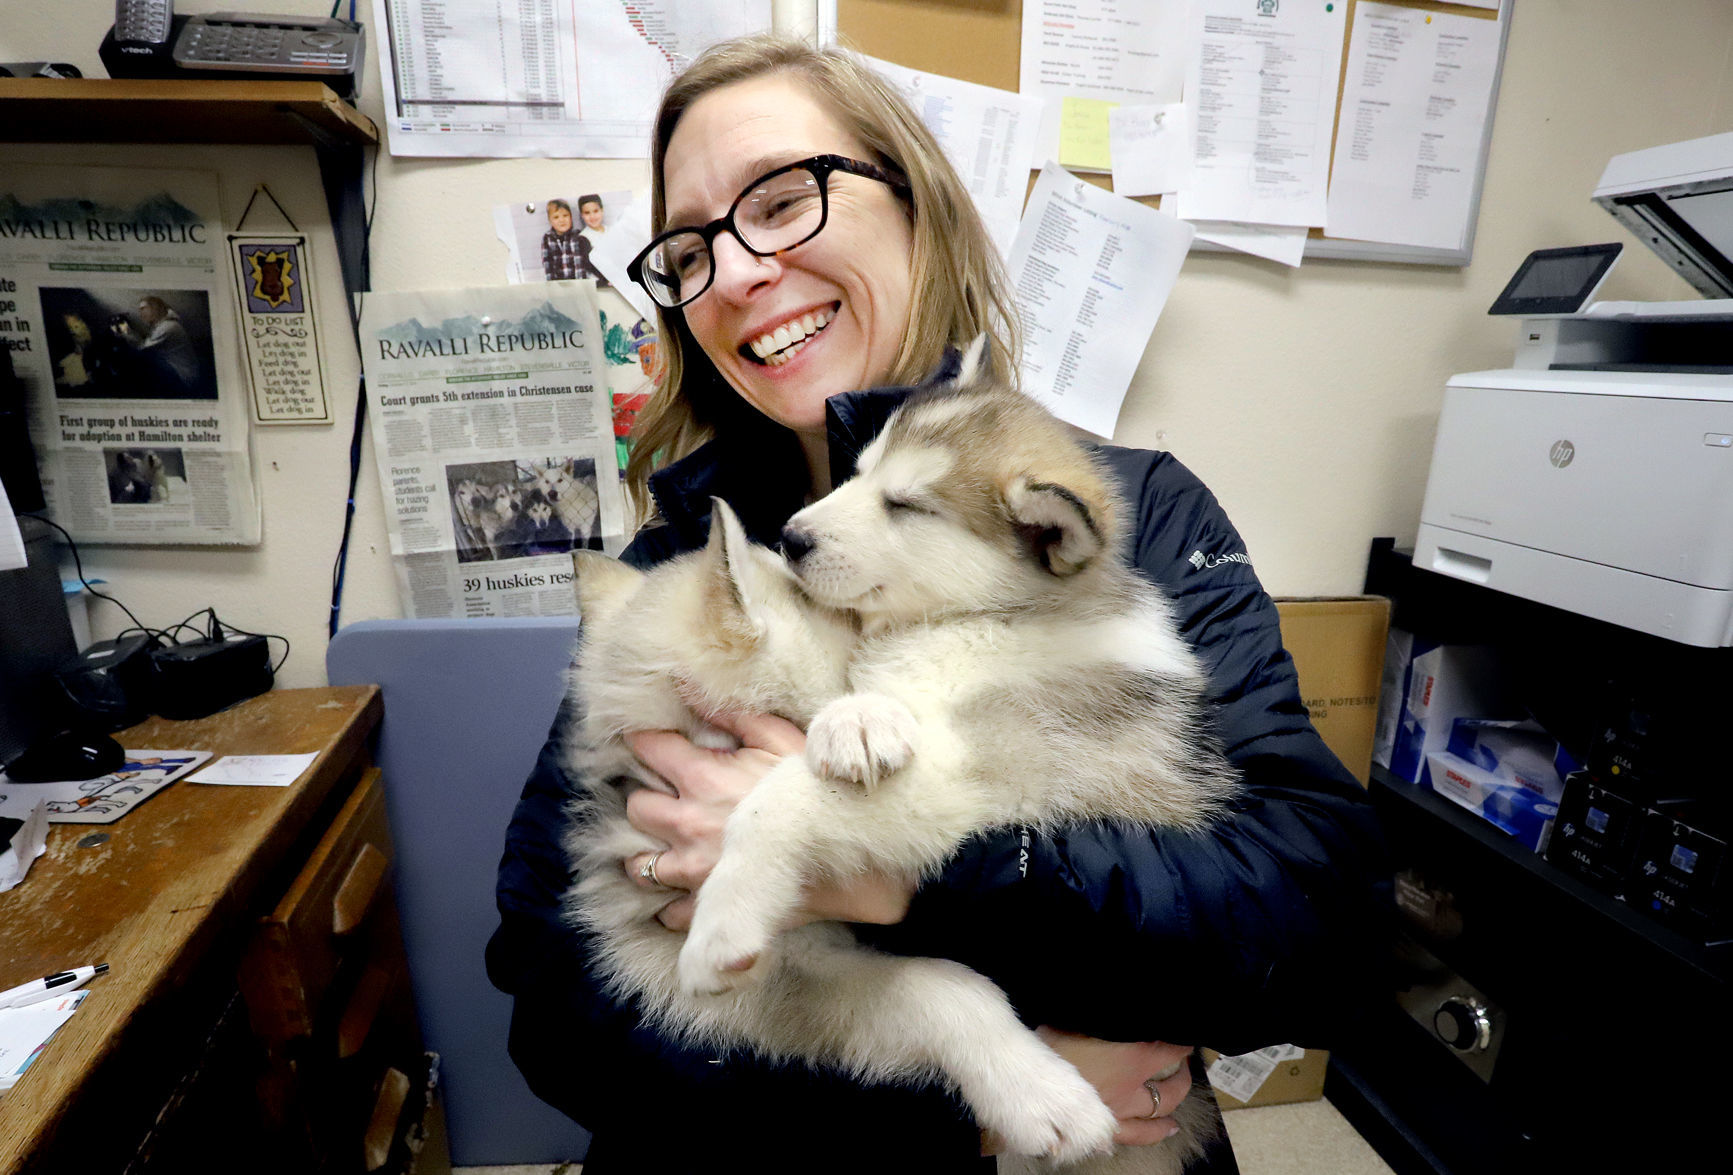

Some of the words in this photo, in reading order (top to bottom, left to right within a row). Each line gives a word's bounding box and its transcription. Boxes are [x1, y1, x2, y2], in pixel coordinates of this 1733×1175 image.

[121, 46, 153, 55] vtech
[86, 218, 206, 244] REPUBLIC
[0, 278, 16, 292] te
[16, 316, 30, 332] in
[266, 316, 282, 326] DO
[285, 317, 305, 326] LIST
[273, 340, 290, 349] dog
[379, 337, 470, 360] RAVALLI
[479, 330, 585, 354] REPUBLIC
[279, 349, 296, 359] dog
[258, 359, 279, 367] Feed
[282, 359, 299, 368] dog
[279, 368, 296, 377] dog
[297, 368, 311, 376] out
[283, 378, 300, 387] dog
[301, 378, 310, 386] in
[263, 387, 286, 395] Walk
[289, 386, 306, 396] dog
[381, 395, 407, 407] Court
[409, 393, 440, 406] grants
[442, 391, 459, 402] 5th
[461, 388, 505, 401] extension
[507, 386, 517, 397] in
[519, 384, 572, 397] Christensen
[574, 384, 594, 394] case
[282, 396, 300, 406] dog
[286, 405, 303, 415] dog
[304, 405, 314, 413] in
[59, 415, 84, 428] First
[86, 417, 116, 429] group
[118, 416, 128, 427] of
[130, 416, 170, 428] huskies
[172, 418, 188, 428] are
[191, 417, 219, 430] ready
[62, 430, 76, 442] for
[79, 430, 122, 444] adoption
[125, 431, 135, 442] at
[138, 431, 184, 443] Hamilton
[187, 431, 221, 443] shelter
[391, 466, 421, 475] Florence
[394, 486, 424, 495] students
[424, 484, 437, 493] call
[395, 497, 405, 505] for
[407, 496, 429, 505] hazing
[397, 505, 428, 514] solutions
[463, 578, 481, 593] 39
[485, 573, 545, 591] huskies
[1302, 699, 1325, 708] ARD
[1612, 754, 1632, 770] 414A
[1446, 769, 1471, 789] STAPLES
[1571, 849, 1591, 865] 414A
[1652, 889, 1675, 907] 414A
